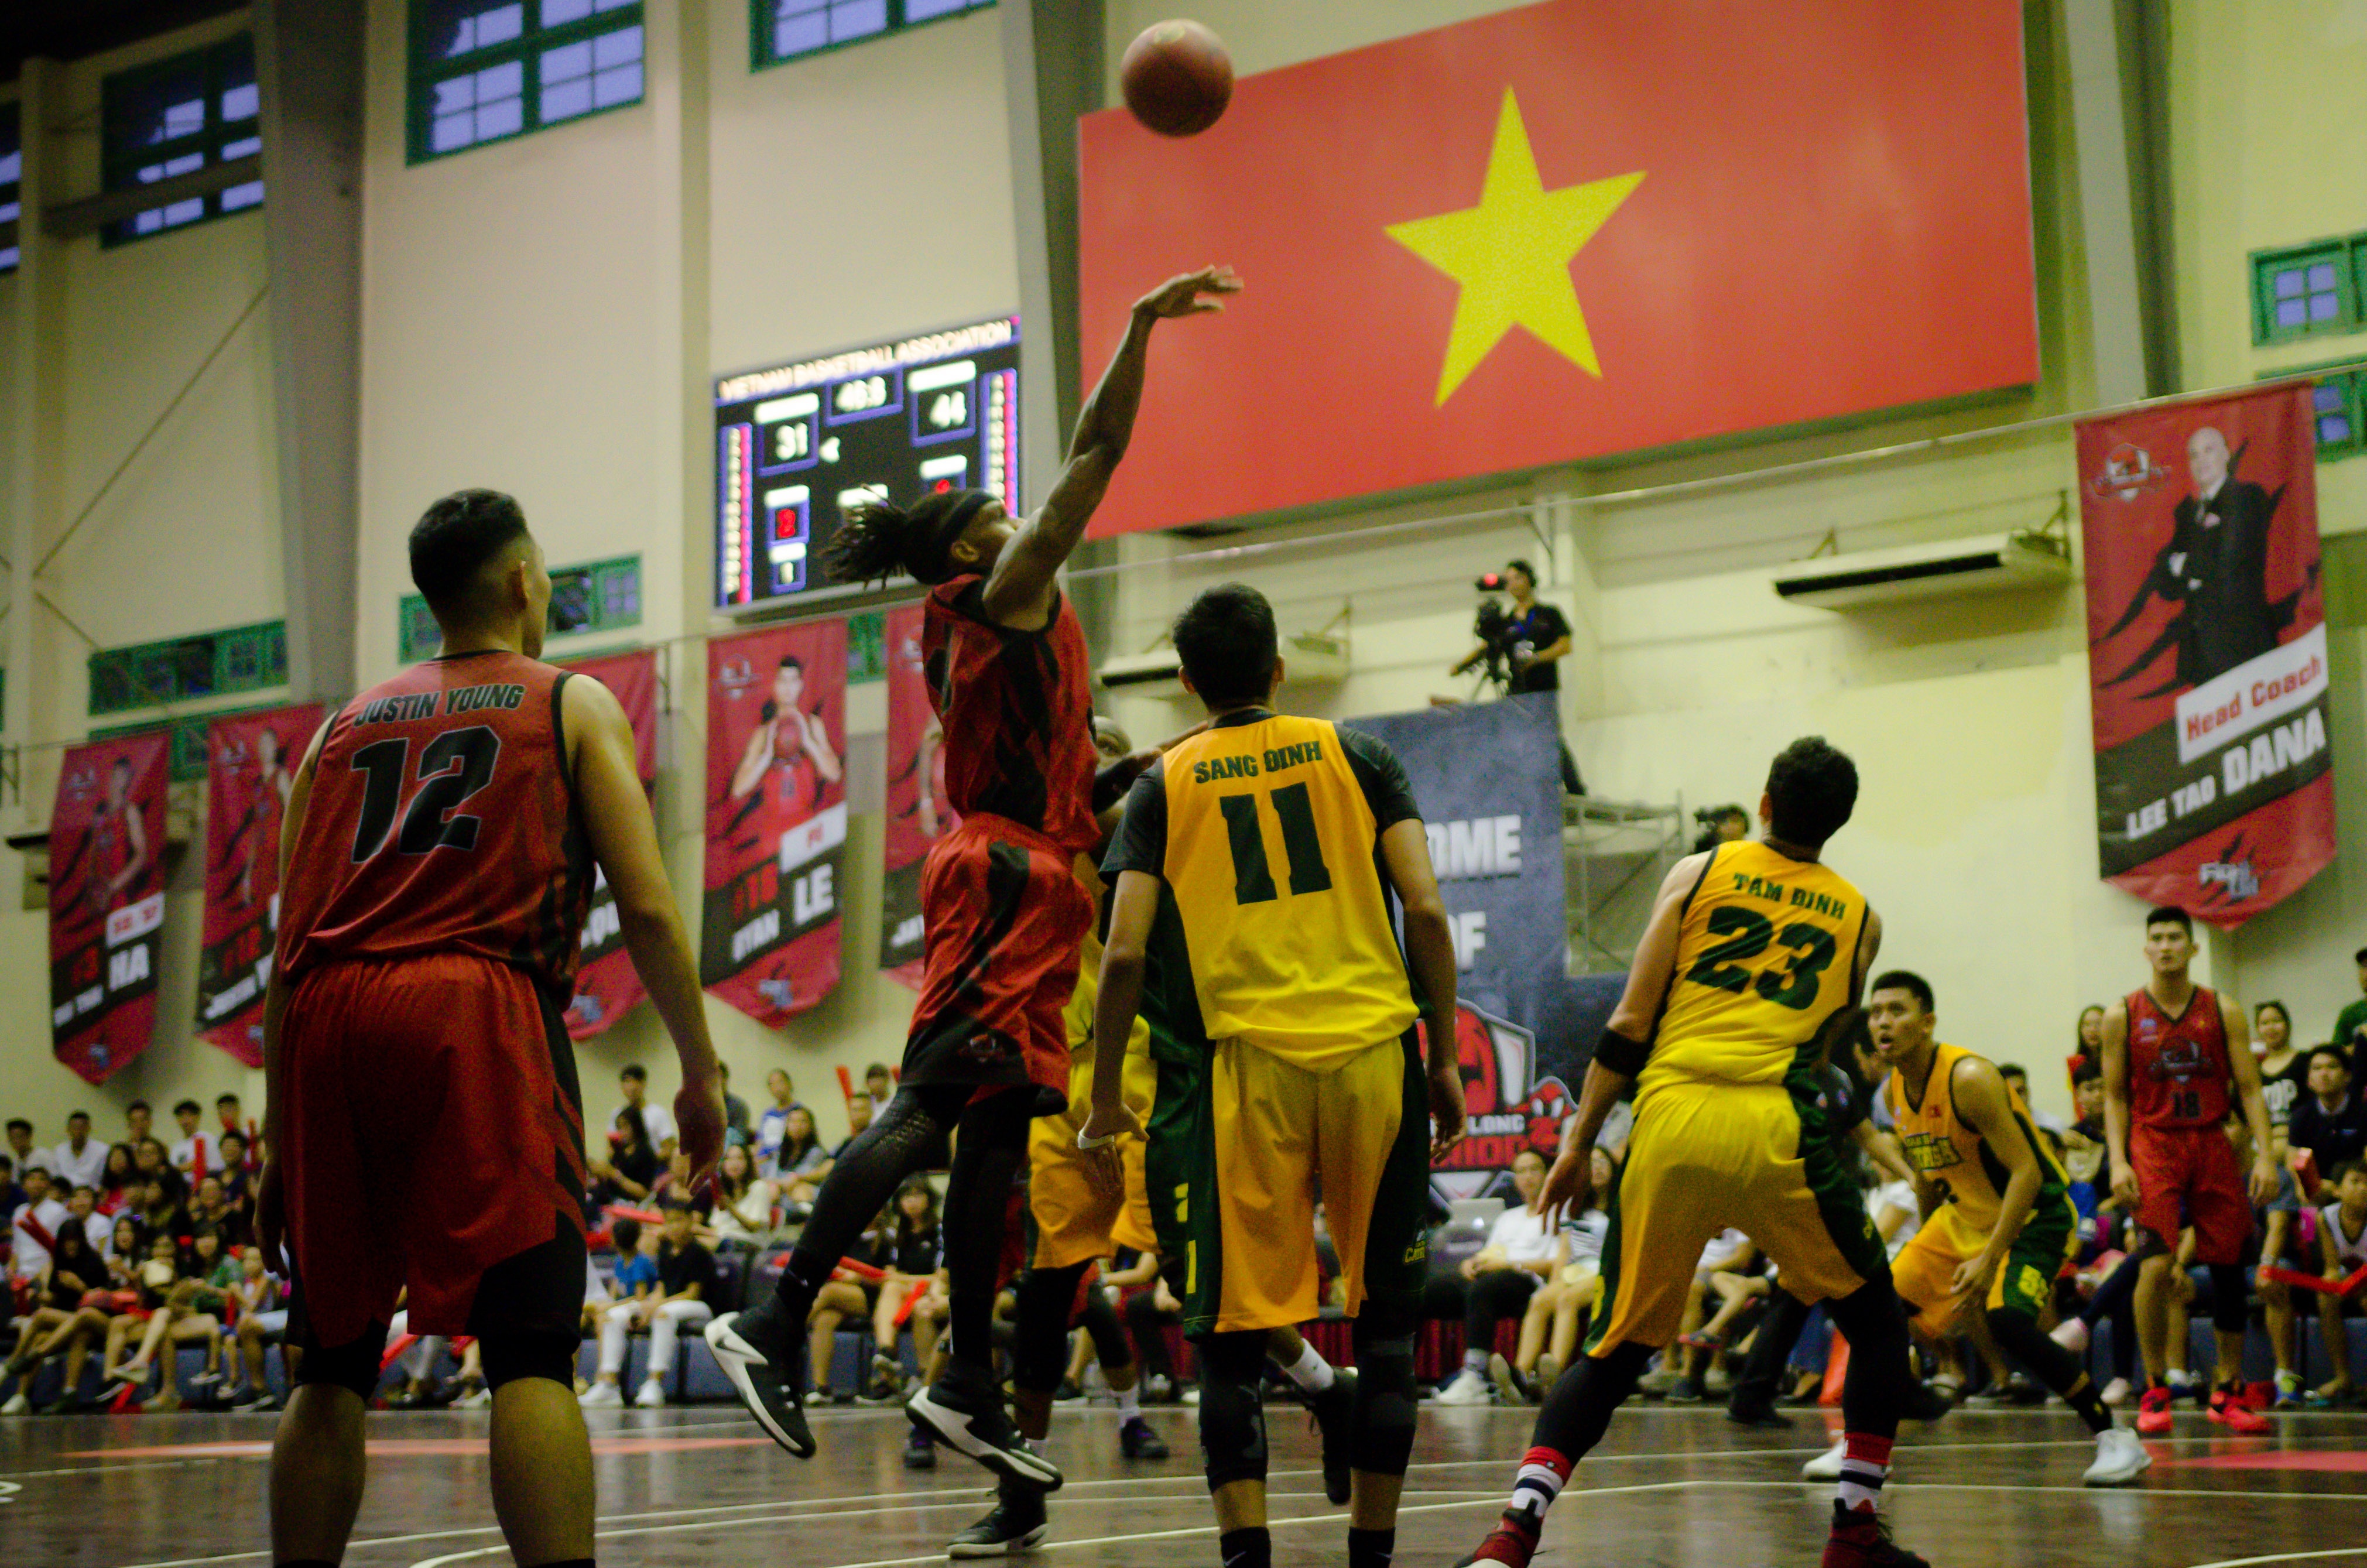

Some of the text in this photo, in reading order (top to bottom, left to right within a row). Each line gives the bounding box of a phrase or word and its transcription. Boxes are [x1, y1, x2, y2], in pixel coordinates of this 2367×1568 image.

[352, 684, 525, 728] JUSTIN YOUNG
[2186, 652, 2322, 742] Head Coach
[351, 725, 502, 864] 12
[1193, 754, 1259, 784] SANG
[2126, 797, 2168, 841] LEE
[2221, 707, 2327, 797] DANA
[1220, 781, 1333, 905] 11
[1424, 814, 1522, 878] OME
[1684, 905, 1837, 1011] 23
[1467, 1114, 1526, 1135] LONG
